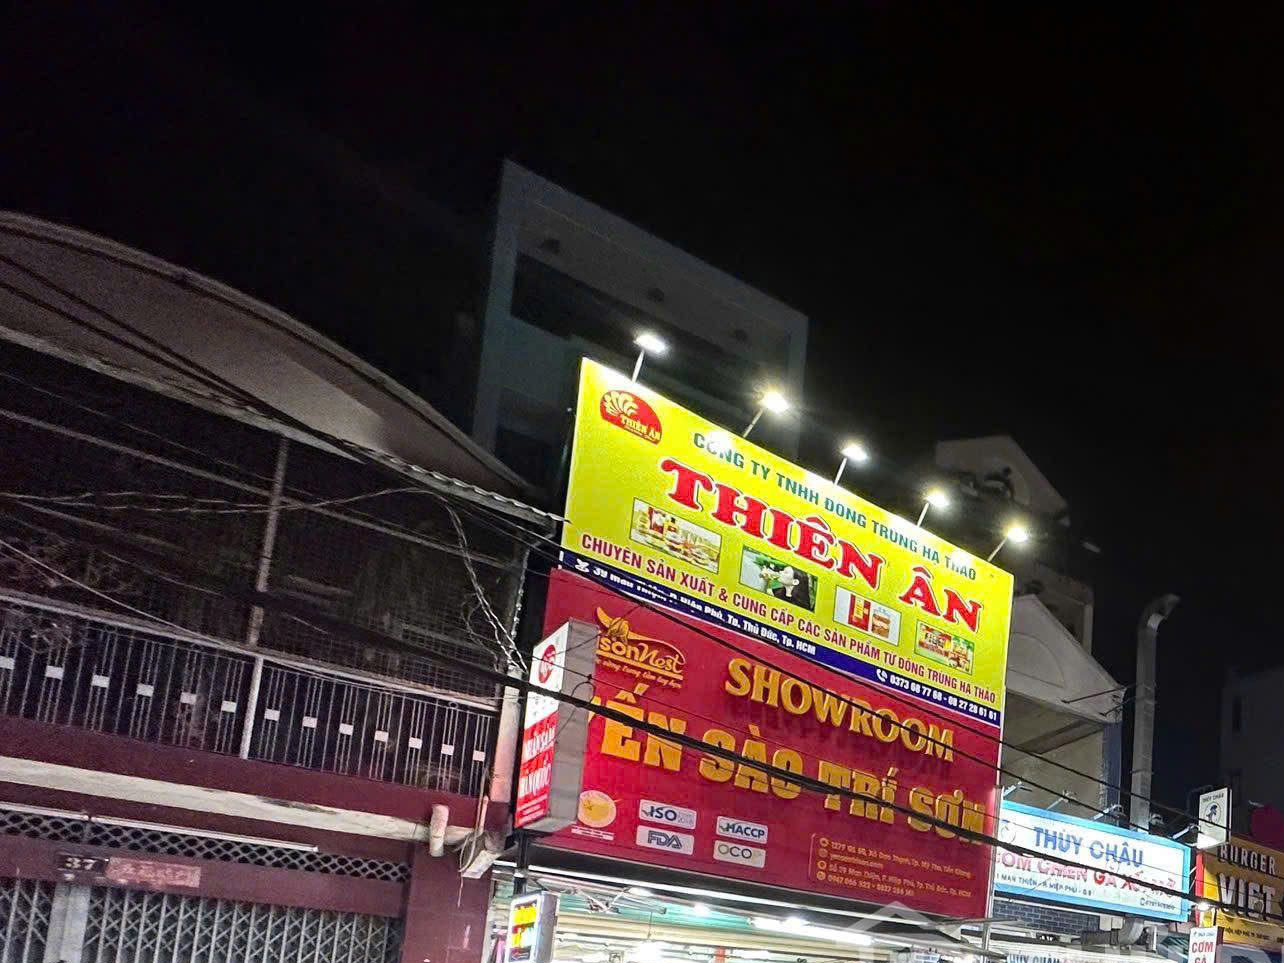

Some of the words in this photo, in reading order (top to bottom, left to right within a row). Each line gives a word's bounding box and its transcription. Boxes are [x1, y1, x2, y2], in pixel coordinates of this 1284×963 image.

[751, 459, 771, 481] TY
[776, 471, 819, 506] TNHH
[660, 458, 886, 591] THIÊN
[899, 565, 984, 633] ÂN
[582, 533, 642, 569] CHUYÊN
[647, 557, 676, 582] SẢN
[680, 571, 716, 597] XUẤT
[718, 588, 729, 602] &
[733, 593, 767, 617] CUNG
[770, 604, 795, 627] CẤP
[797, 616, 820, 638] CÁC
[823, 627, 847, 649] SẢN
[796, 640, 816, 656] HCM
[725, 657, 955, 763] SHOWROOM
[700, 724, 804, 800] SÀO
[818, 766, 900, 826] TRÍ
[650, 805, 678, 822] ISO
[648, 830, 683, 850] FDA
[726, 822, 765, 839] HACCP
[1089, 840, 1144, 868] CHÂU
[1191, 940, 1214, 953] CƠM
